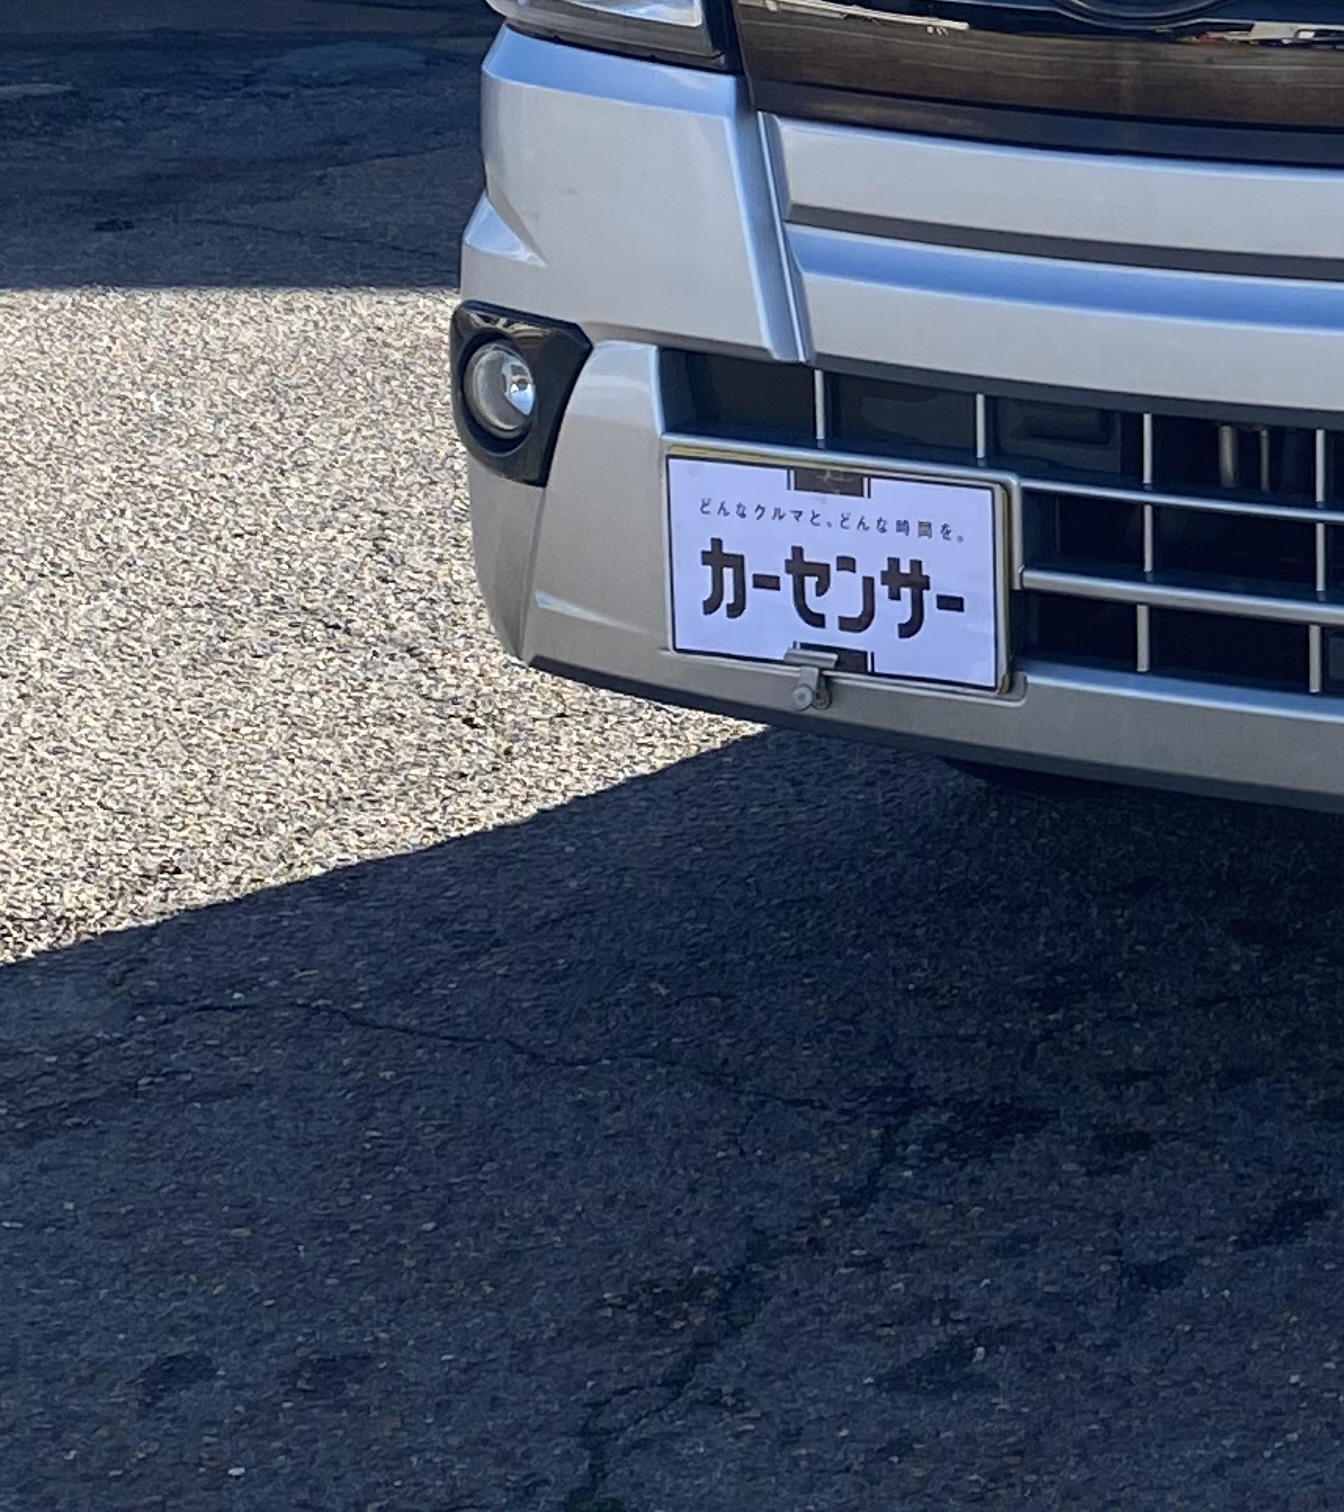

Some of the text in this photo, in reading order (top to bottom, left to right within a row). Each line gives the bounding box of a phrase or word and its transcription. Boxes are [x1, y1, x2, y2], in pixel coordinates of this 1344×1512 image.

[700, 536, 965, 640] カーセンサー
